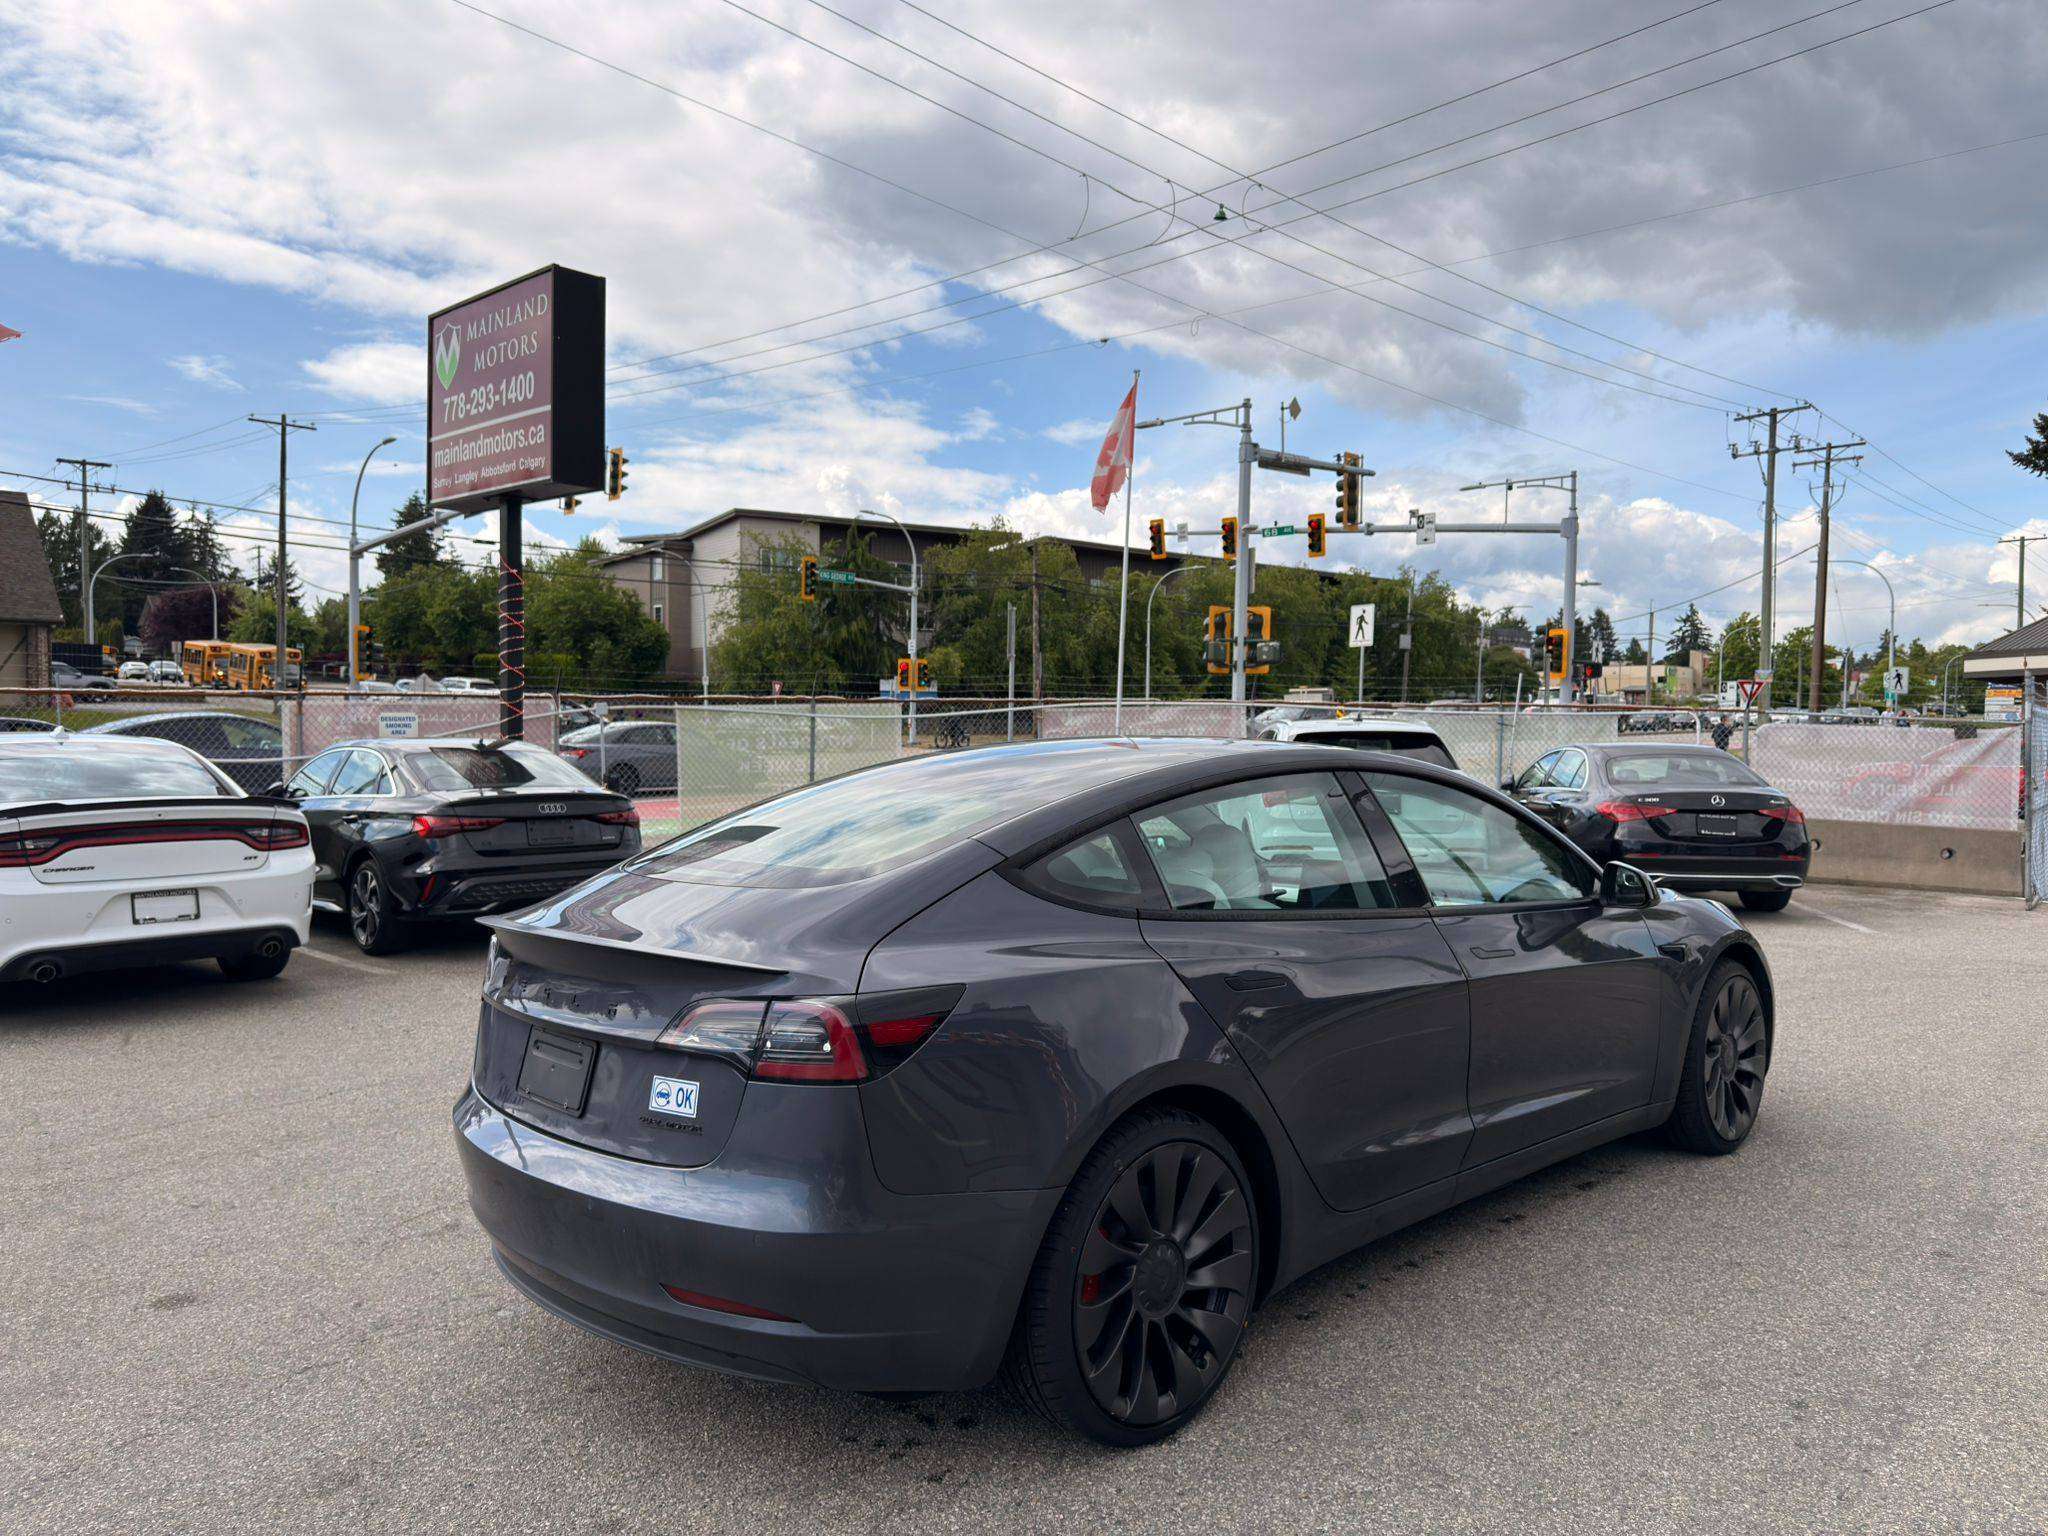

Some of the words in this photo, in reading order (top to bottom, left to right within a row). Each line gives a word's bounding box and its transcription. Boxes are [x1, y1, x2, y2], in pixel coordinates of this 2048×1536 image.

[466, 293, 548, 342] MAINLAND
[474, 331, 538, 372] MOTORS
[443, 371, 534, 423] 778-293-1400
[434, 424, 545, 468] mainlandmotors.ca
[455, 470, 478, 484] Langley
[481, 459, 516, 478] Abbotsford
[519, 456, 545, 471] Calgary
[43, 865, 95, 873] CHARGER
[676, 1087, 694, 1109] OK
